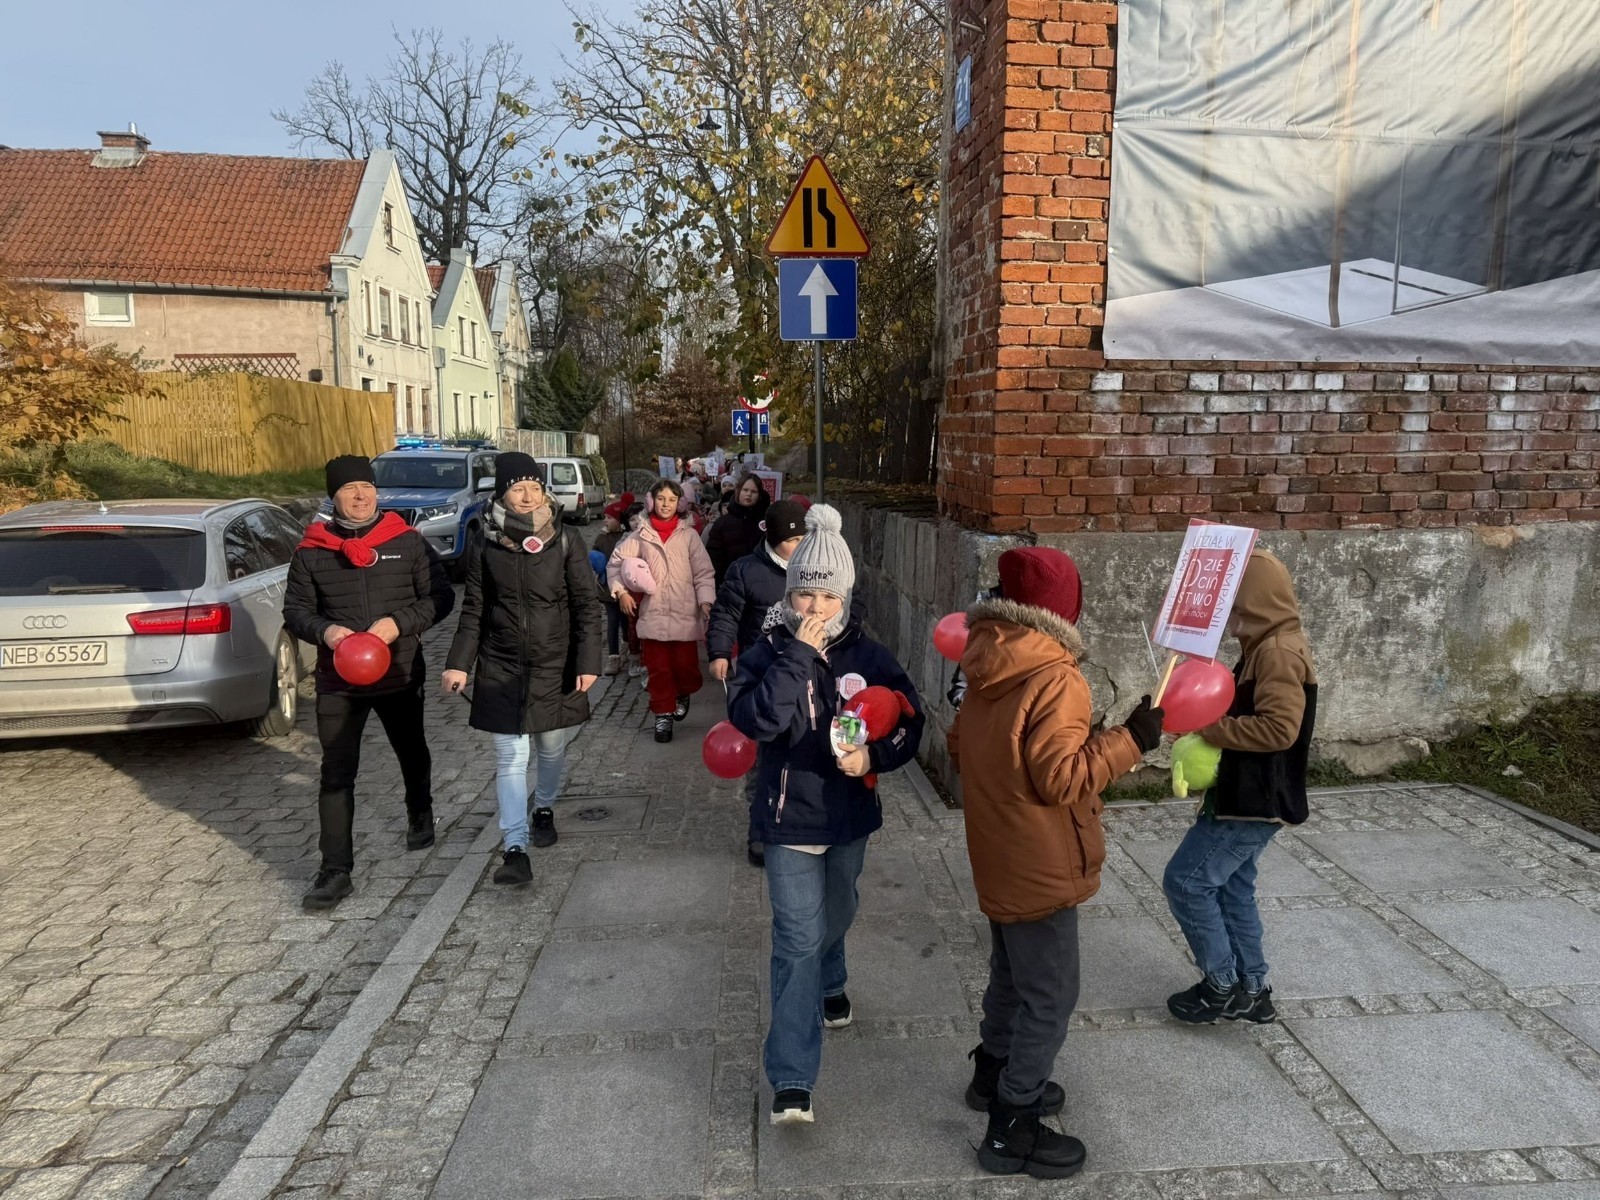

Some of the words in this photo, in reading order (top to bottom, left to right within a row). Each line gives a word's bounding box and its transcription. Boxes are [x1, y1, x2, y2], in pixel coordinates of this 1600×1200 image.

[1177, 591, 1214, 607] STWO
[1210, 551, 1240, 628] KAMPANII
[2, 647, 38, 665] NEB
[45, 644, 103, 662] 65567
